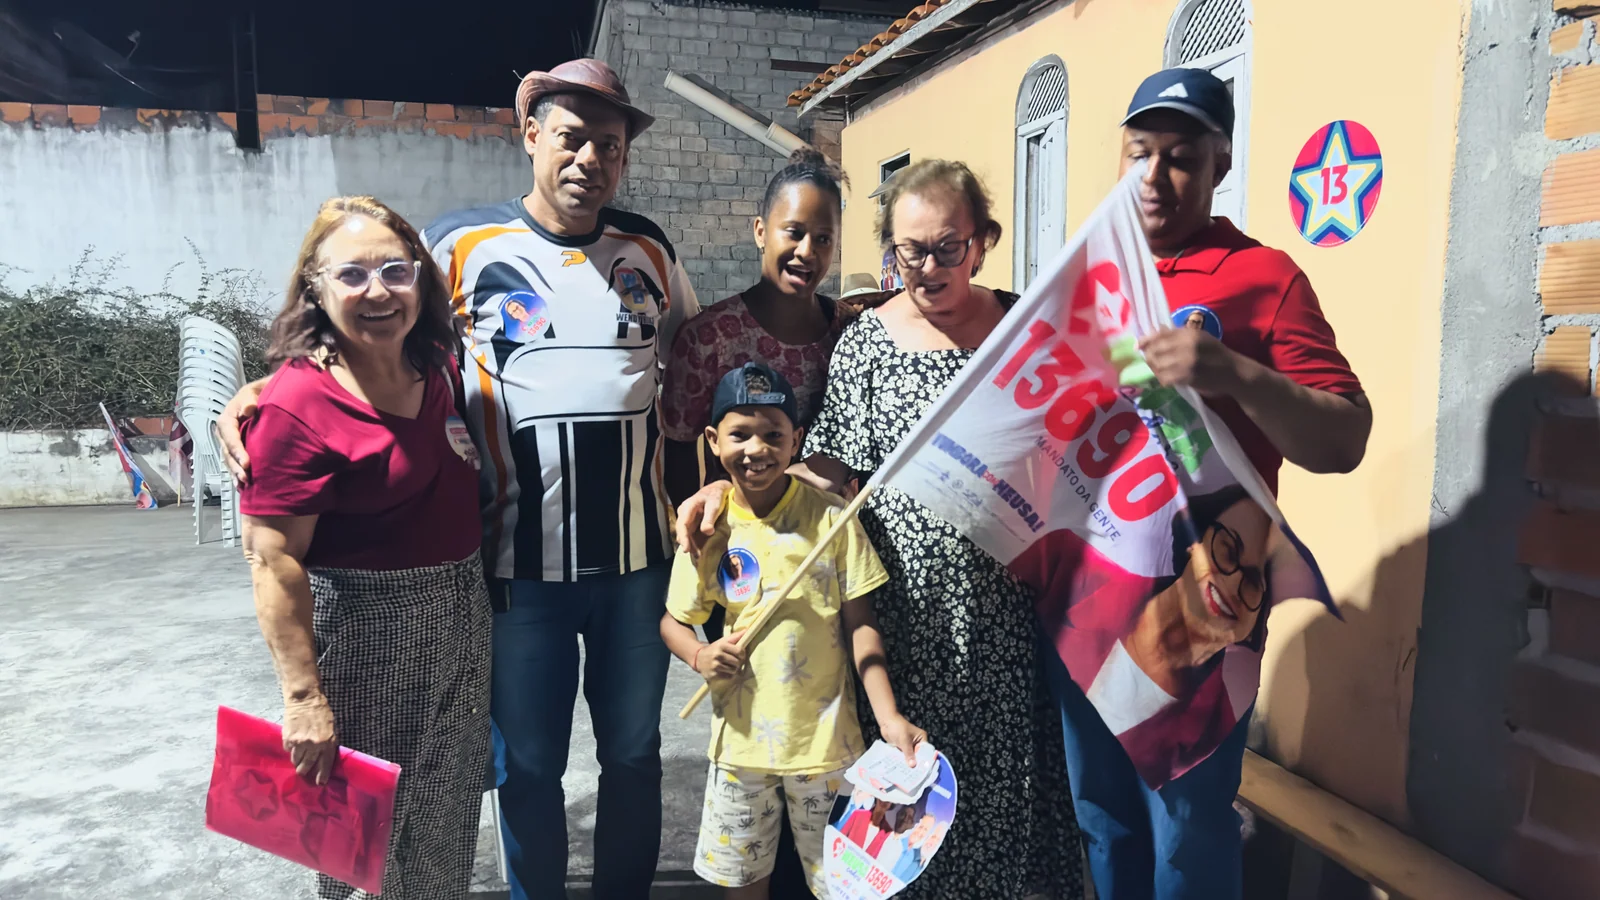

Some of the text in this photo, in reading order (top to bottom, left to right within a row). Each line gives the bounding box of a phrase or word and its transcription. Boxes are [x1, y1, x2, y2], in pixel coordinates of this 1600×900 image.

[1320, 164, 1348, 205] 13
[993, 318, 1179, 521] 13690
[993, 479, 1045, 533] NEUSA!
[1036, 436, 1121, 541] MANDATO DA GENTE
[866, 865, 893, 894] 13690
